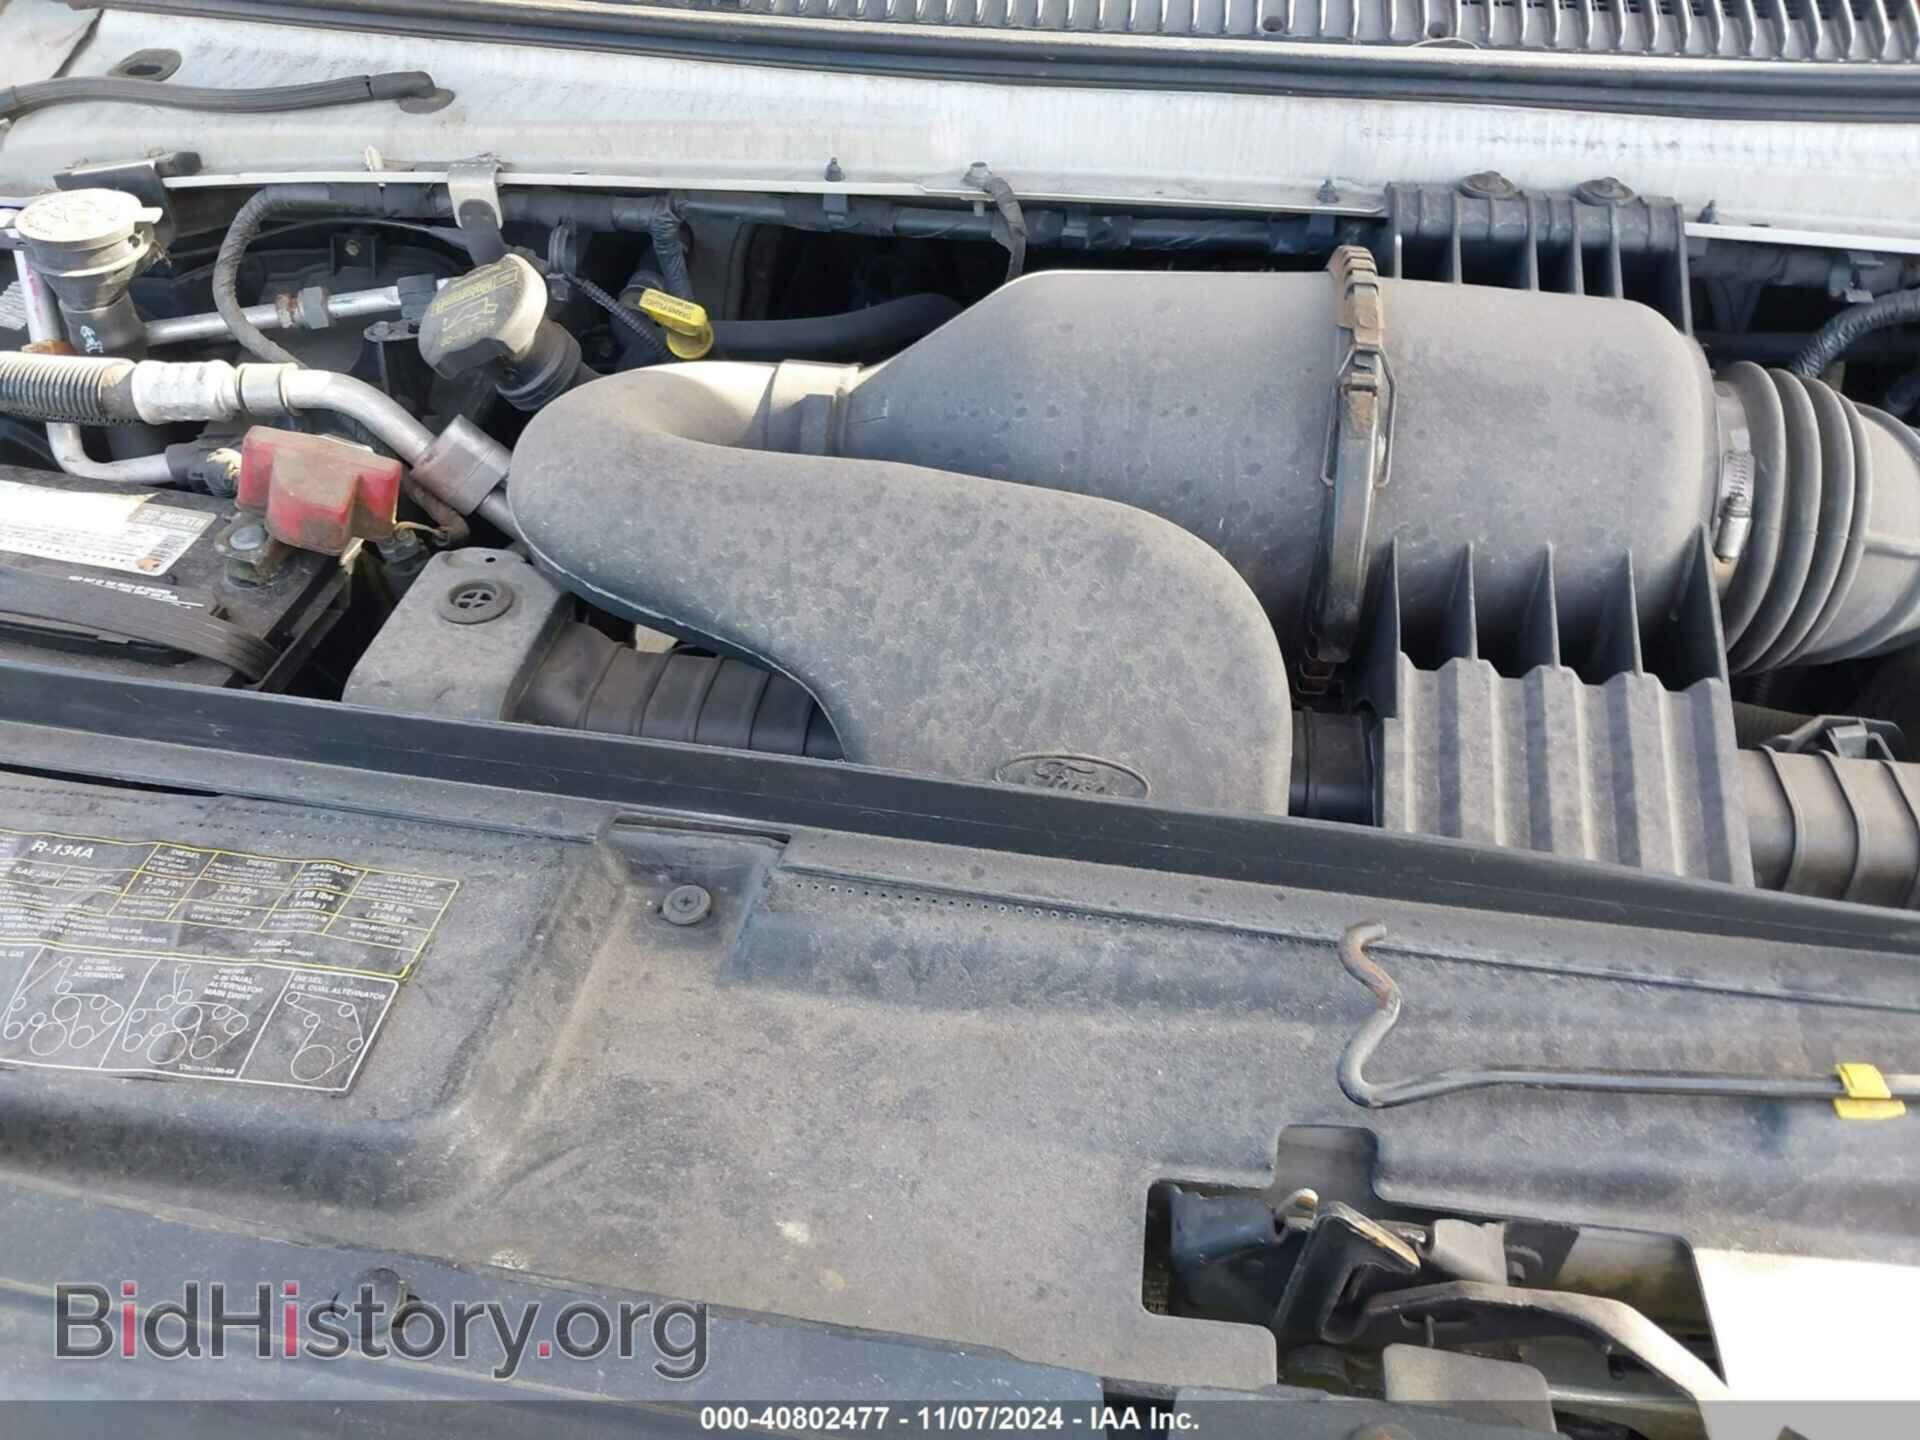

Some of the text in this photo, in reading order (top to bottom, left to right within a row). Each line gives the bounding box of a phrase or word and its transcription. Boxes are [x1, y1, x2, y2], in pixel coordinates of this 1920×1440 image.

[30, 840, 95, 859] R-134A
[310, 862, 359, 877] GASOLINE
[387, 875, 437, 888] GASOLINE
[207, 980, 264, 994] ALTERNATOR
[330, 988, 386, 1001] ALTERNATOR
